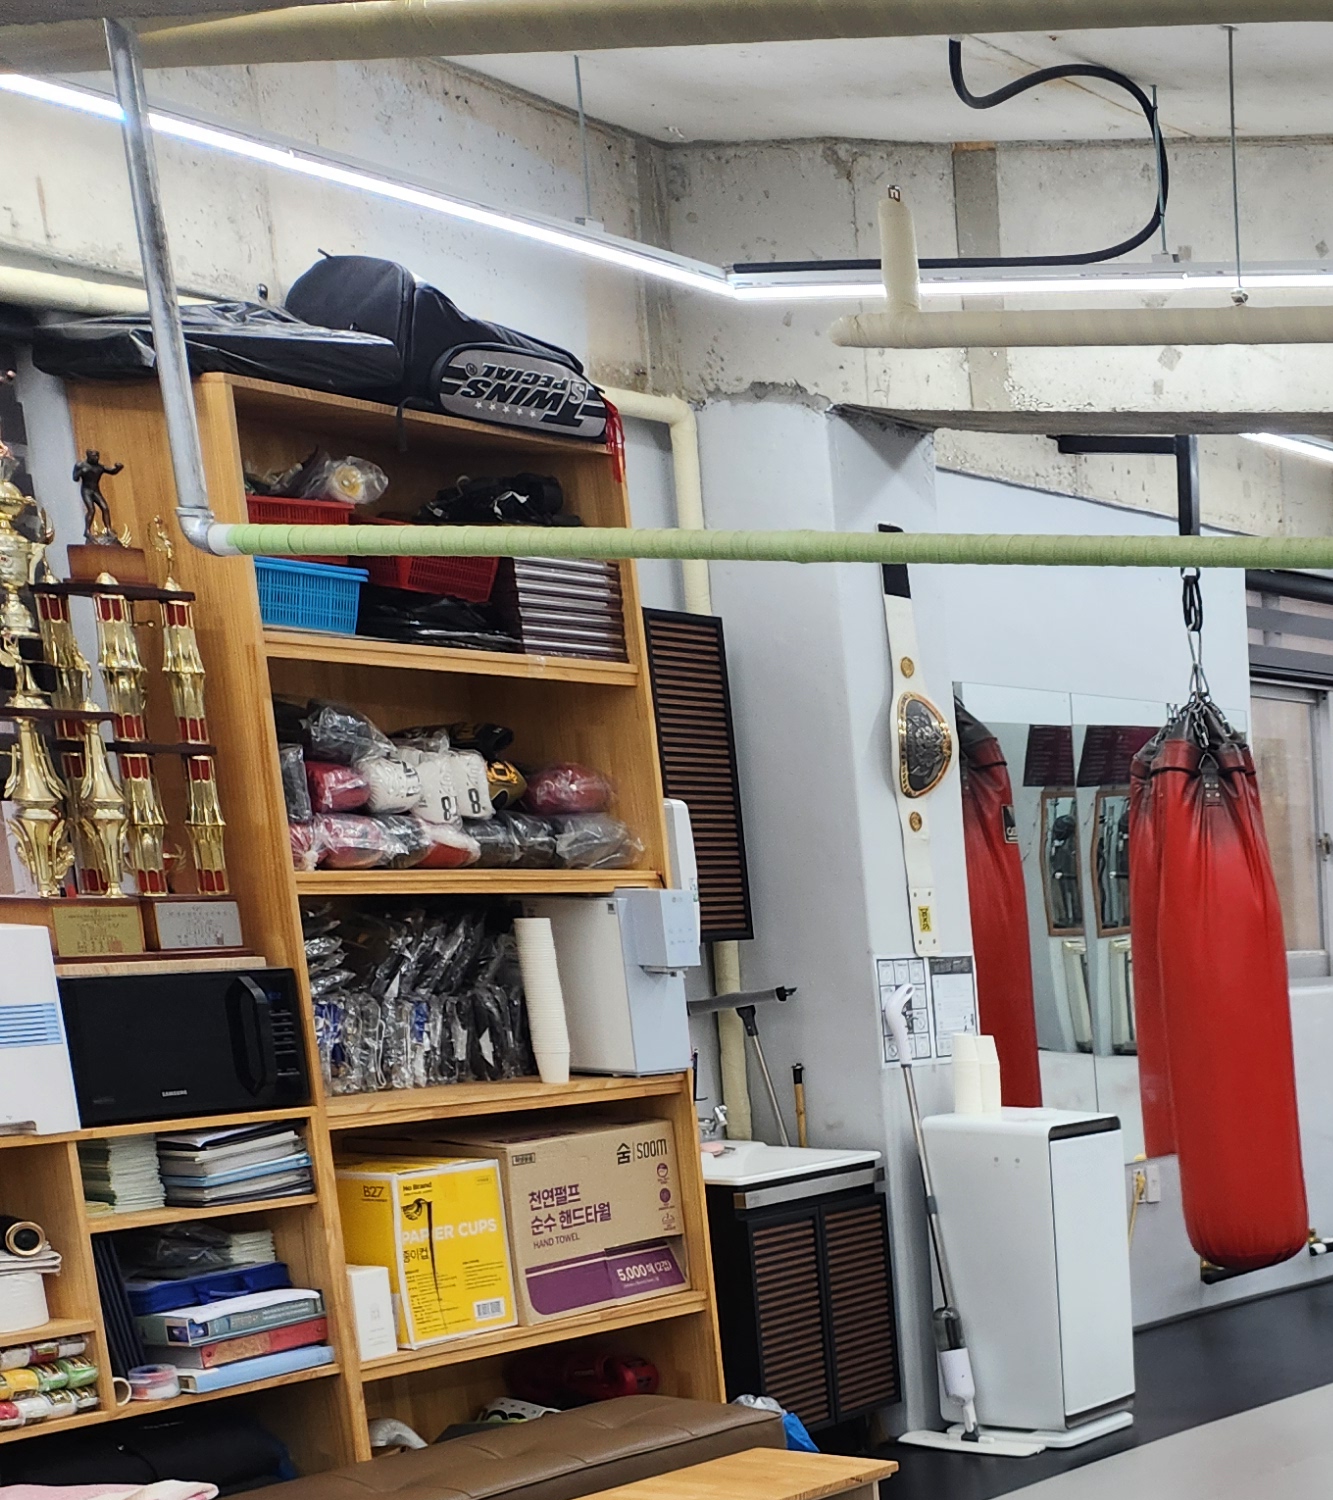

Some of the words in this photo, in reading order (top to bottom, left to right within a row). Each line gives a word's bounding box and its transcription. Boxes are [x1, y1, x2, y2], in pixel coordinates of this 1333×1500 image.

[482, 363, 588, 403] SPECIAL
[460, 377, 585, 427] TWINS
[528, 1183, 582, 1211] 천연펄프
[401, 1224, 454, 1246] PAPER
[458, 1218, 497, 1237] CUPS
[531, 1214, 557, 1236] 순수
[559, 1202, 612, 1230] 핸드타월
[533, 1238, 554, 1250] HAND
[556, 1232, 580, 1244] TOWEL
